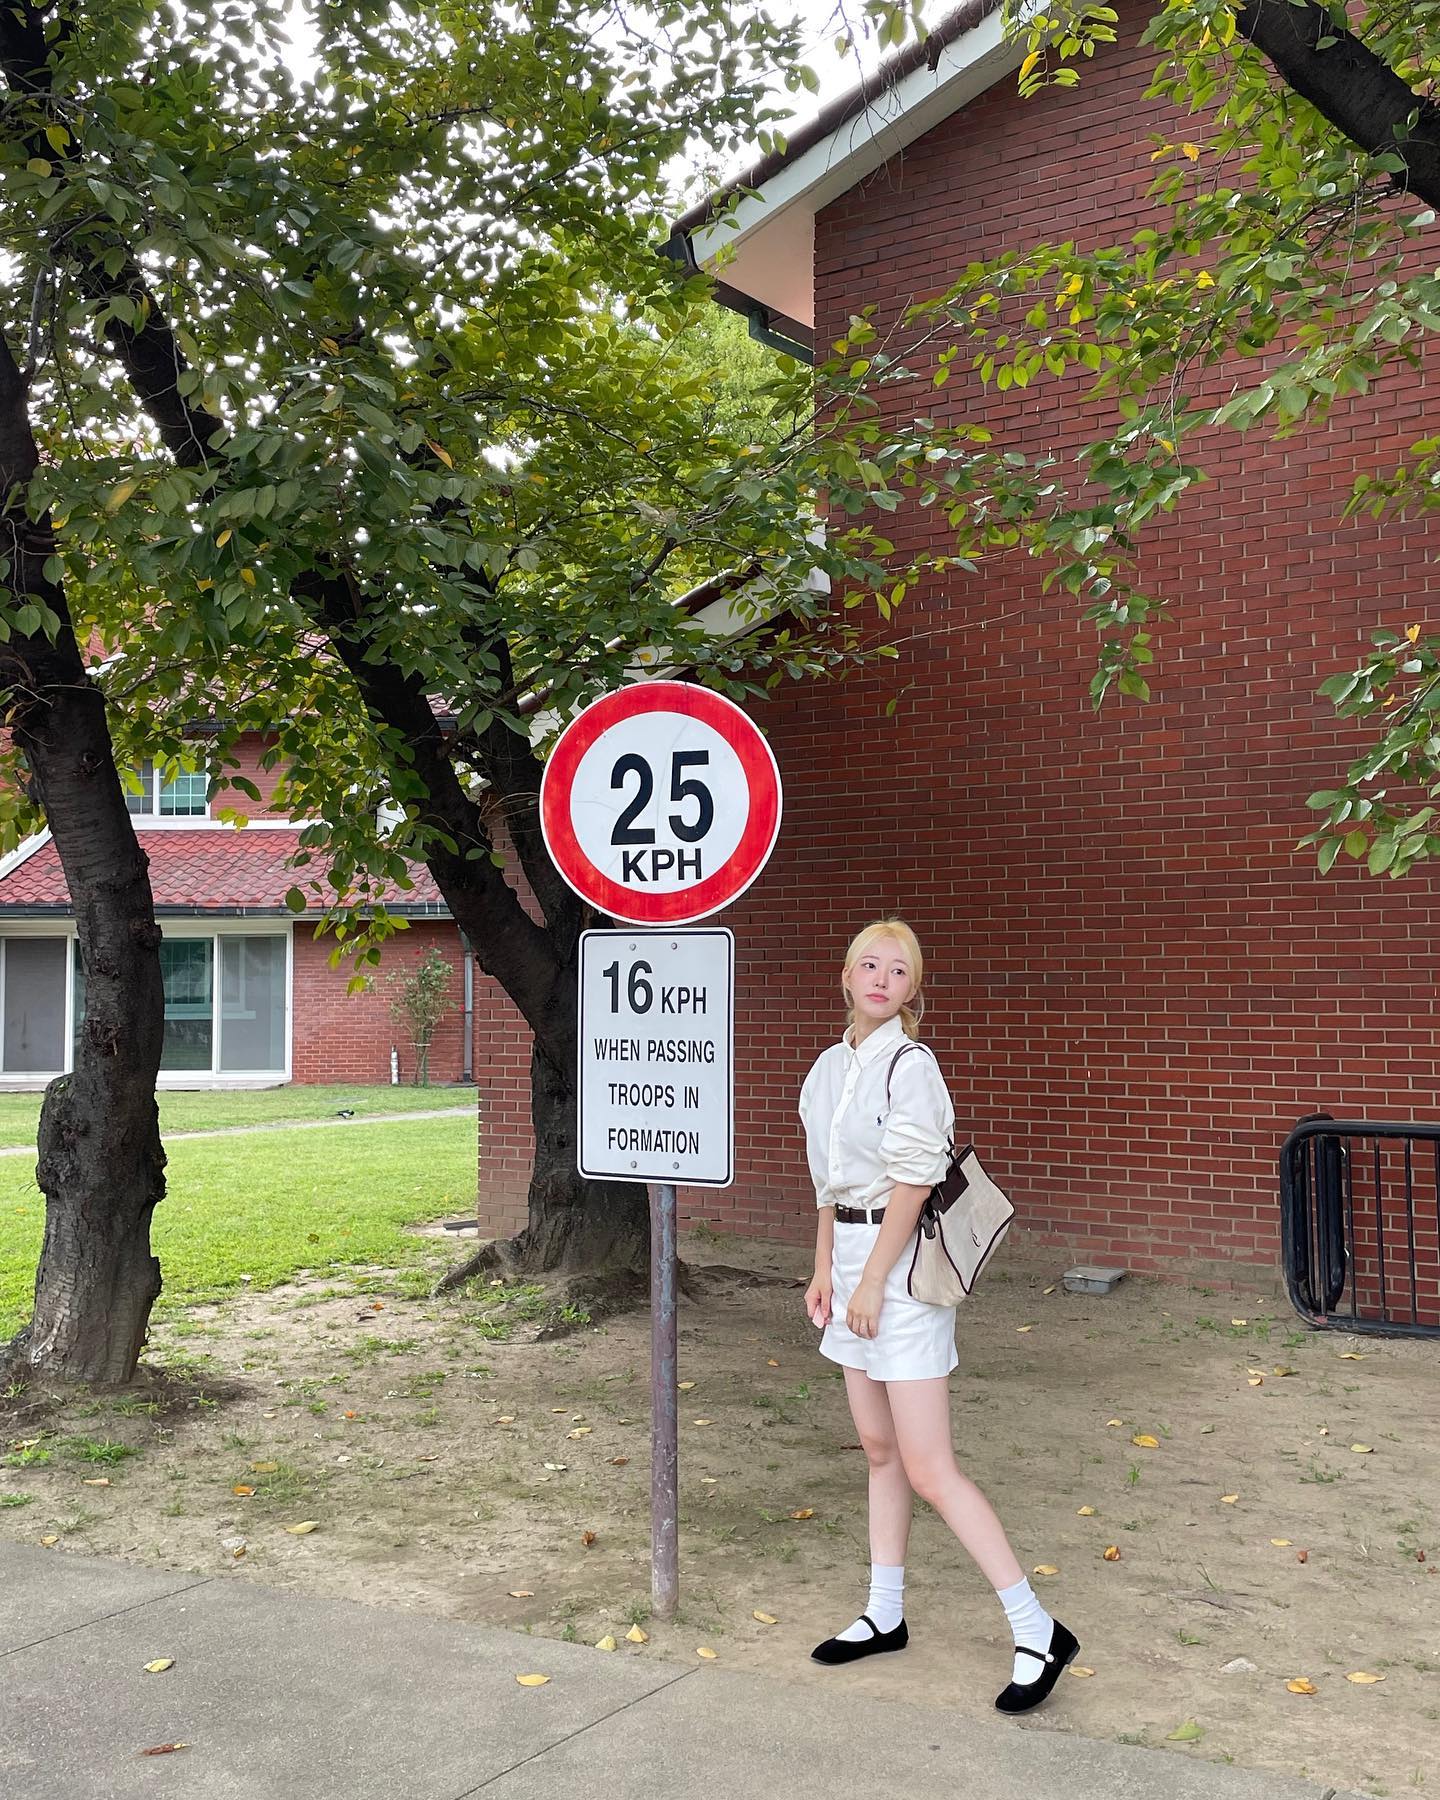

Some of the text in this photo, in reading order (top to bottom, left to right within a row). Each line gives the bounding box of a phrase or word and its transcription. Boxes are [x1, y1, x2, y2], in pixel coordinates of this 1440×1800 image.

[610, 749, 715, 846] 25
[622, 847, 702, 883] KPH
[602, 960, 707, 1015] 16 KPH
[594, 1038, 715, 1064] WHEN PASSING
[608, 1082, 699, 1109] TROOPS IN
[608, 1127, 699, 1155] FORMATION
